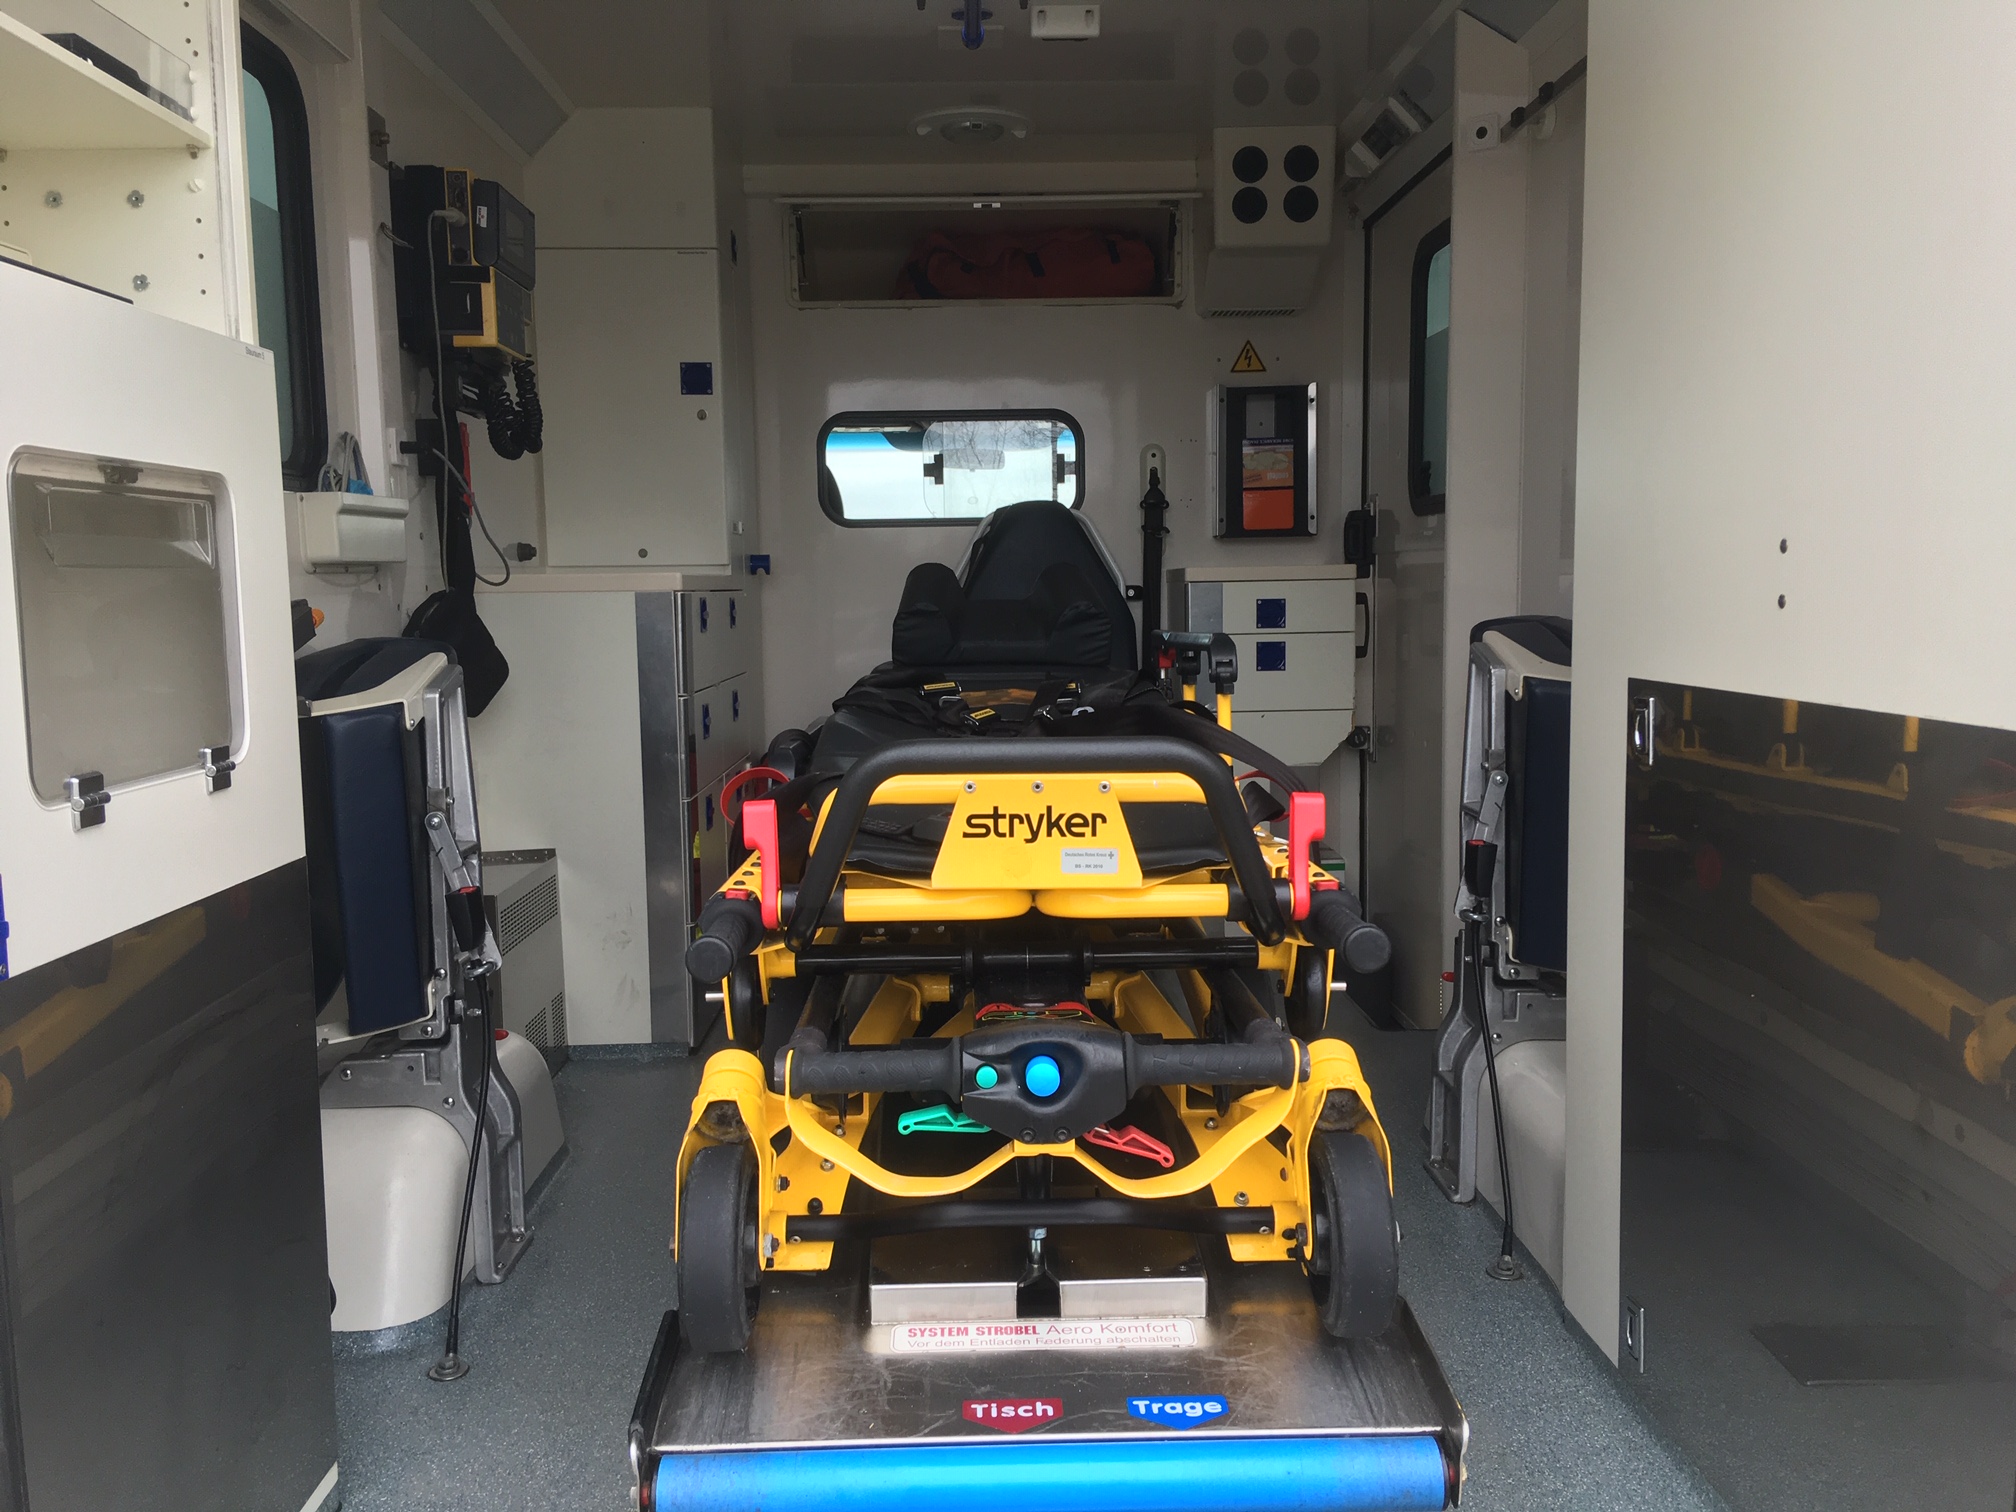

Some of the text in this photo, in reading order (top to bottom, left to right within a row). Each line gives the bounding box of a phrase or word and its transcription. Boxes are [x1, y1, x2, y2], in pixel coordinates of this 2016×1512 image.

[962, 805, 1107, 844] stryker
[908, 1322, 1179, 1338] SYSTEM STROBEL Aero Komfort
[908, 1334, 1181, 1348] Vor dem Entladen Federung abschalten
[971, 1401, 1054, 1418] Tisch
[1132, 1399, 1222, 1417] Trage
